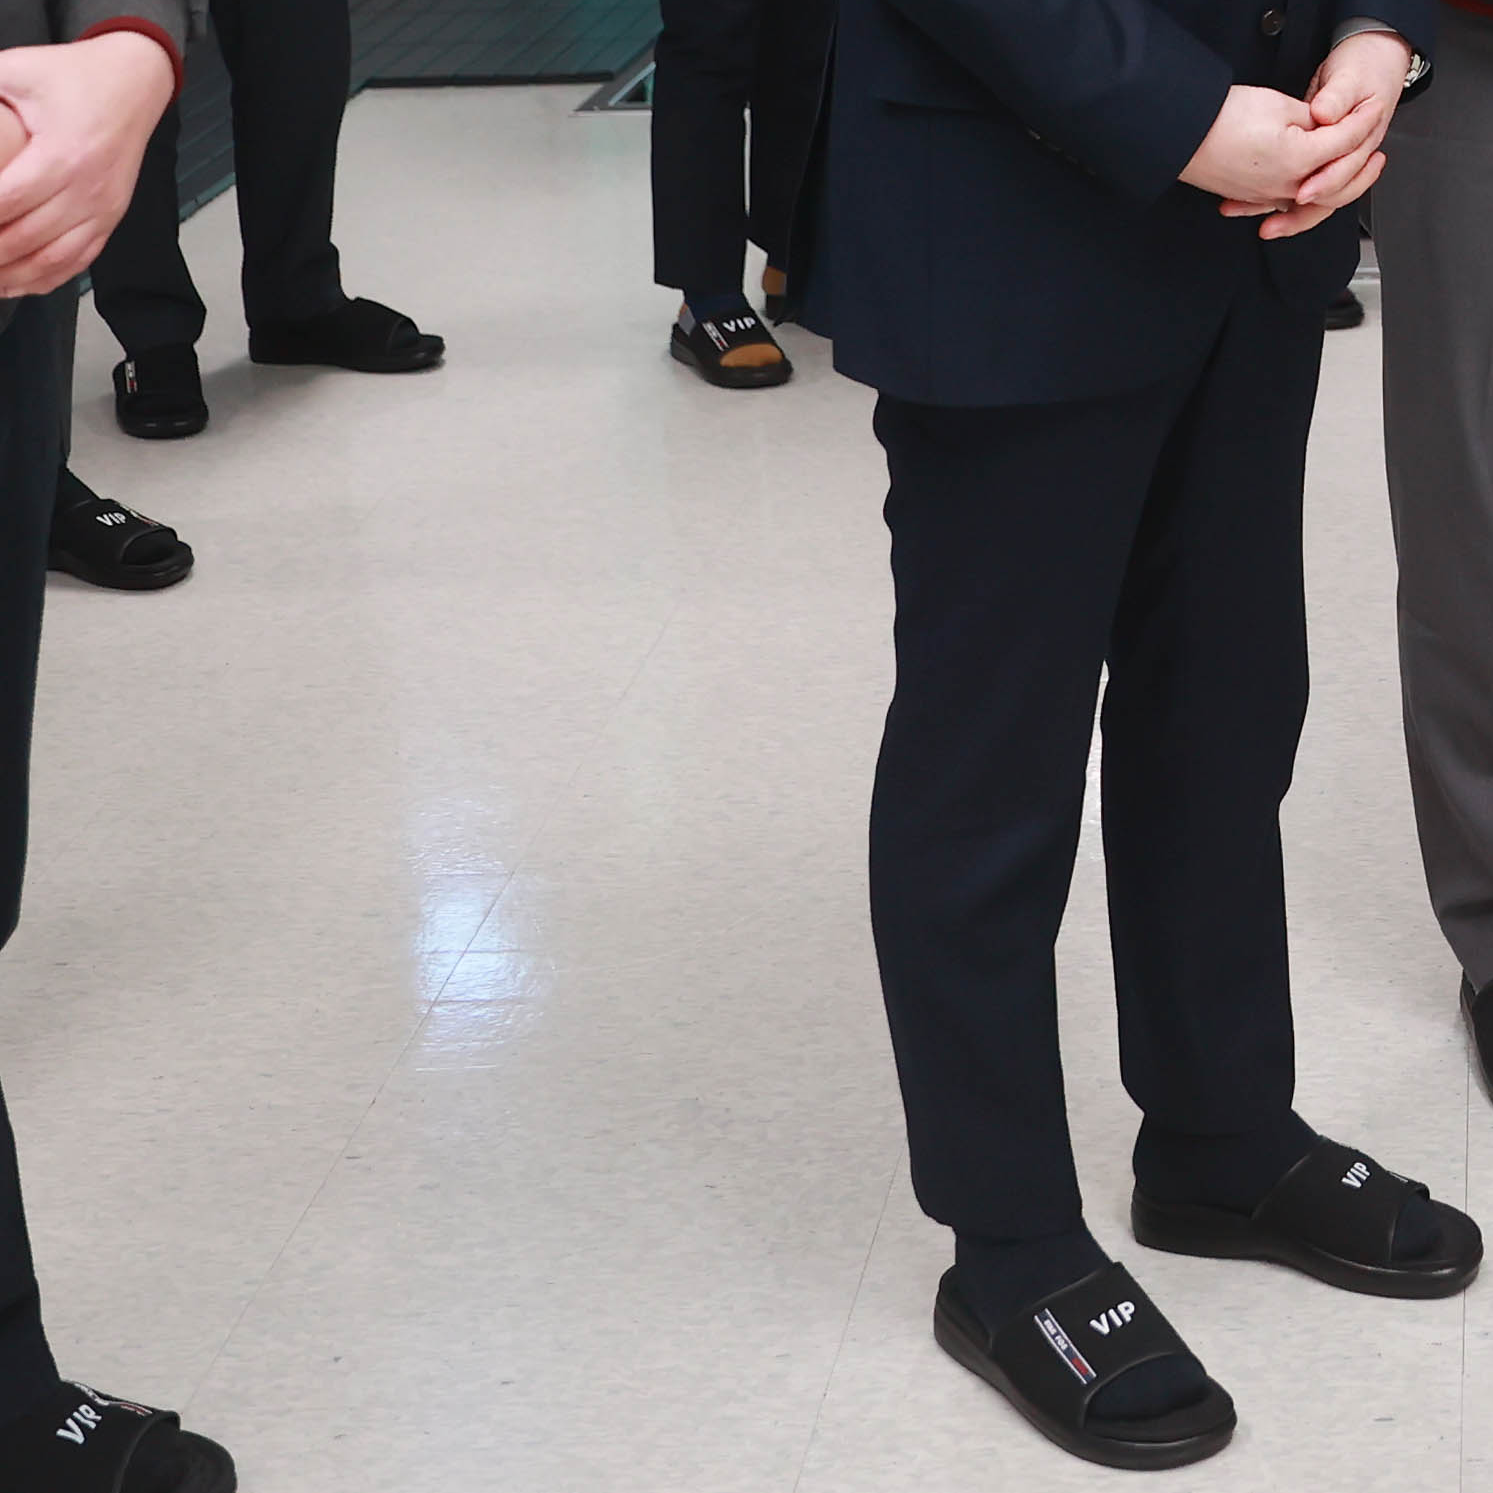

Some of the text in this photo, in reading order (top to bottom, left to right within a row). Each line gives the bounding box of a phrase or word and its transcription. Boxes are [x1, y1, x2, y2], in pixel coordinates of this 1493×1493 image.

[722, 316, 756, 333] VIP
[96, 511, 126, 526] VIP
[1341, 1161, 1371, 1189] VIP
[1090, 1301, 1135, 1337] VIP
[56, 1404, 102, 1445] VIP
